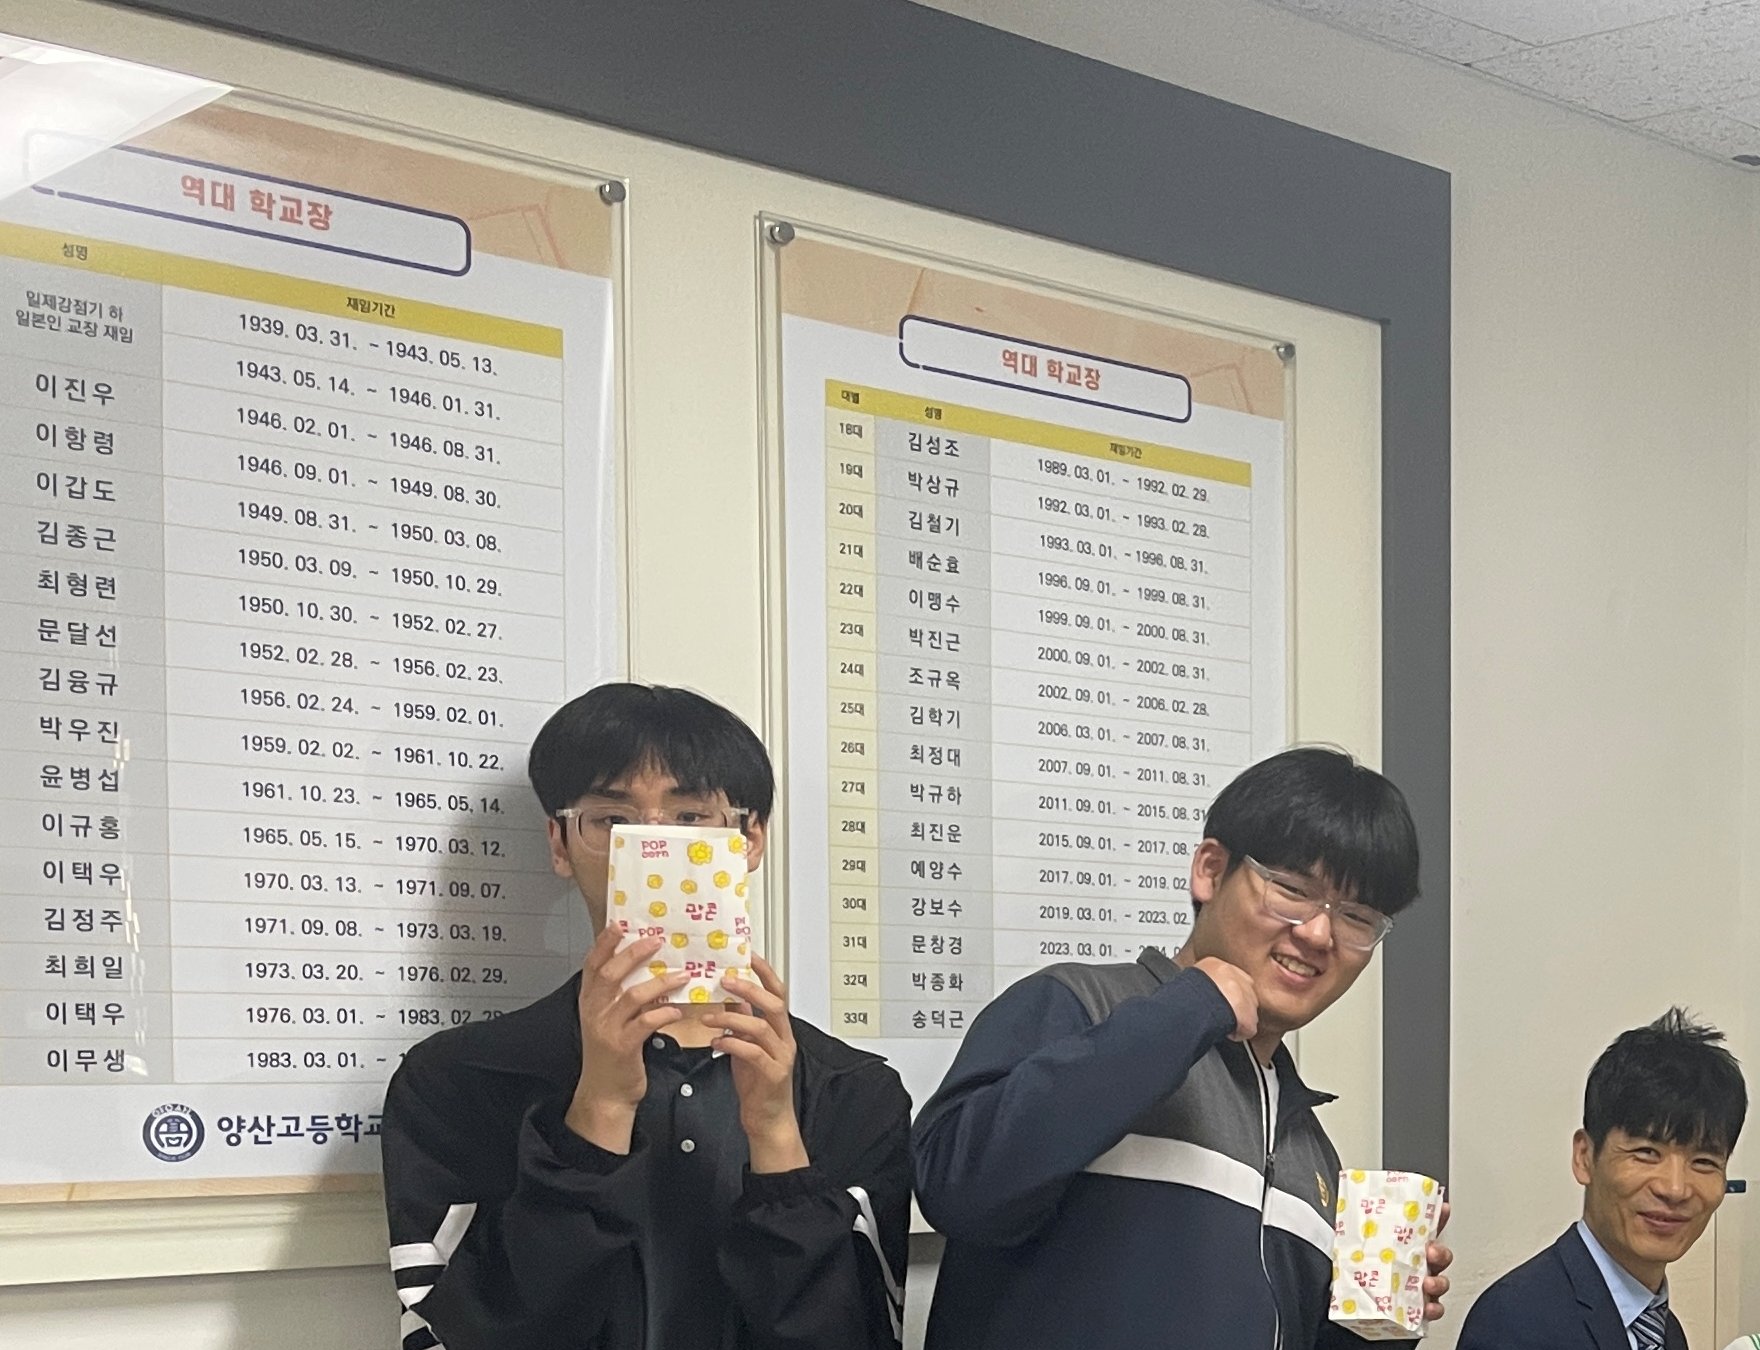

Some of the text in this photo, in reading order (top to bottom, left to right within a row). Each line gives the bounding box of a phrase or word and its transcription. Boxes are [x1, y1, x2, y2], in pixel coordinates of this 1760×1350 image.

[180, 174, 334, 232] 역대 학교장
[62, 242, 89, 261] 성명
[26, 290, 124, 322] 일제강점기 하
[346, 295, 396, 318] 재임기간
[15, 309, 134, 344] 일본인 교장 재임
[239, 313, 289, 339] 1939.
[295, 323, 324, 345] 03.
[329, 329, 358, 351] 31.
[386, 340, 434, 365] 1943.
[439, 349, 466, 370] 05.
[472, 356, 498, 376] 13.
[1002, 349, 1101, 391] 역대 학교장
[839, 422, 862, 439] 18대
[839, 462, 863, 479] 19대
[838, 502, 863, 519] 20대
[237, 501, 289, 525] 1949.
[294, 508, 323, 529] 08.
[328, 513, 357, 533] 31.
[391, 522, 439, 544] 1950.
[444, 528, 470, 549] 03.
[475, 533, 502, 553] 08.
[839, 542, 863, 559] 21대
[839, 582, 863, 598] 22대
[839, 621, 863, 638] 23대
[1038, 609, 1072, 627] 1999.
[1074, 613, 1094, 629] 09.
[1096, 616, 1116, 633] 01.
[1136, 622, 1169, 641] 2000.
[1171, 627, 1189, 643] 08.
[1192, 630, 1210, 646] 31.
[840, 661, 864, 677] 24대
[240, 688, 291, 709] 1956.
[296, 692, 326, 712] 02.
[331, 696, 359, 715] 24.
[393, 702, 441, 722] 1959.
[446, 706, 473, 725] 02.
[477, 709, 504, 728] 01.
[840, 701, 864, 717] 25대
[840, 741, 864, 756] 26대
[841, 780, 865, 796] 27대
[841, 820, 865, 835] 28대
[641, 840, 667, 850] POP
[841, 858, 866, 874] 29대
[842, 897, 866, 912] 30대
[842, 935, 866, 950] 31대
[843, 973, 867, 988] 32대
[843, 1012, 867, 1025] 33대
